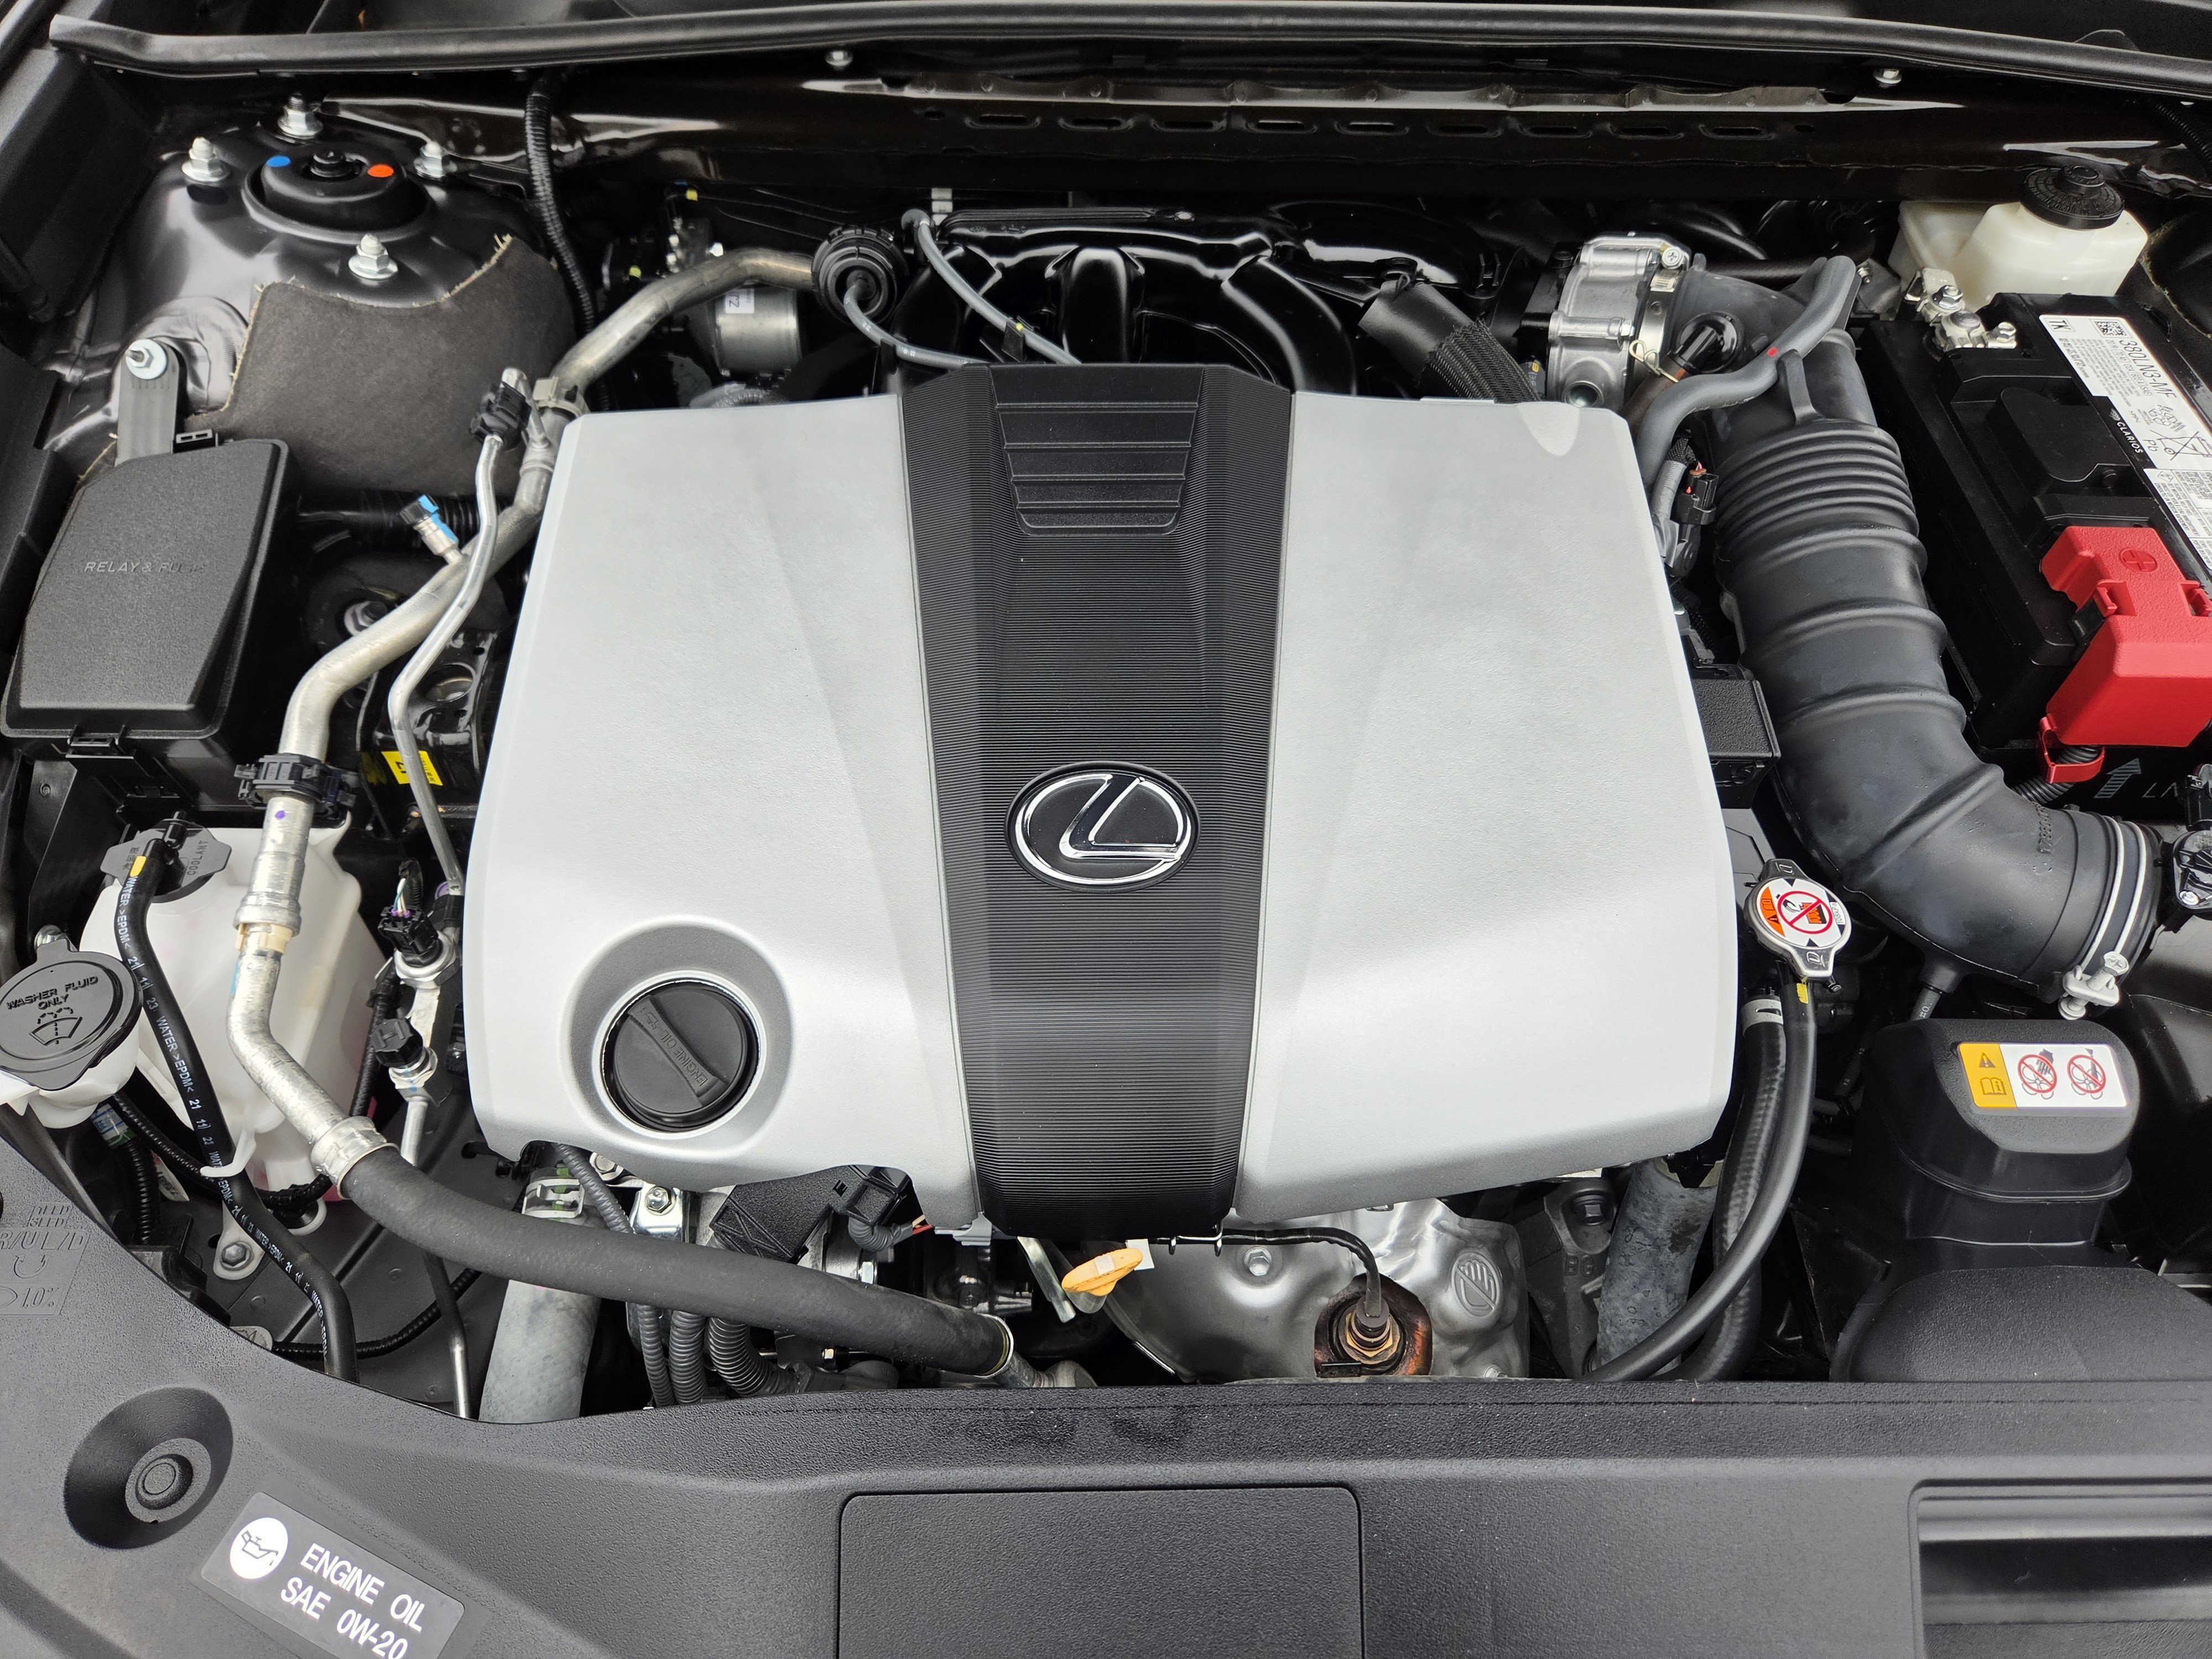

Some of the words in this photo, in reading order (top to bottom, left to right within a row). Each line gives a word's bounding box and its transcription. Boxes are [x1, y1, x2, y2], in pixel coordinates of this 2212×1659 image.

[2048, 320, 2072, 331] TK
[2119, 340, 2178, 399] 380LN3-MF
[2117, 421, 2143, 453] CLARIOS
[84, 561, 140, 573] RELAY
[142, 562, 152, 573] &
[187, 840, 208, 876] COOLANT
[119, 876, 138, 907] WATER
[117, 909, 132, 950] >EPDM<
[7, 988, 58, 1010] WASHER
[65, 976, 98, 993] FLUID
[38, 993, 70, 1010] ONLY
[155, 1015, 178, 1052] WATER
[173, 1053, 194, 1093] >EPDM<
[209, 1151, 223, 1168] WAT
[300, 1542, 385, 1606] ENGINE
[389, 1593, 425, 1632] OIL
[280, 1577, 332, 1620] SAE
[336, 1609, 409, 1659] 0W-20
